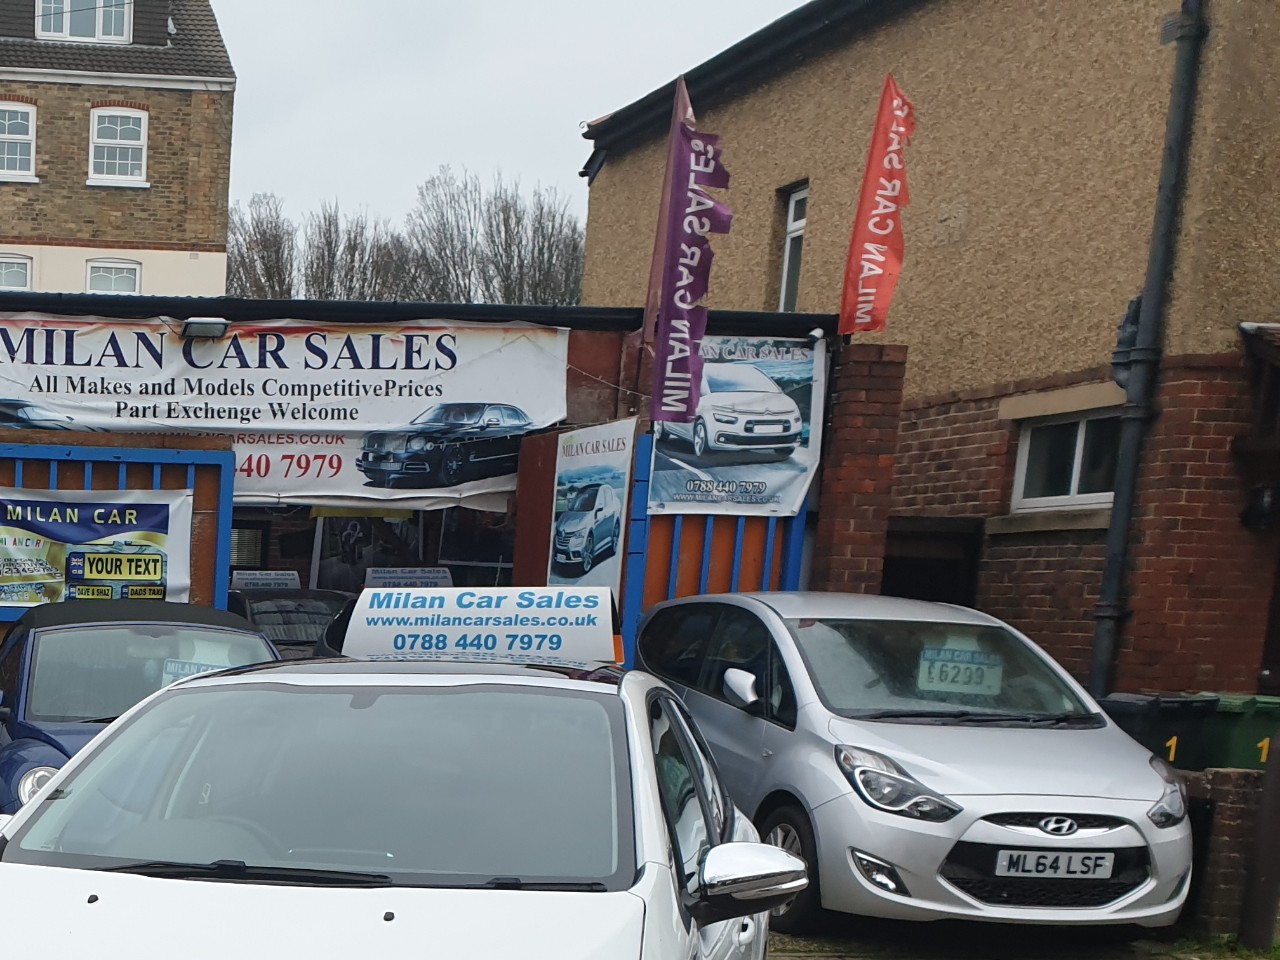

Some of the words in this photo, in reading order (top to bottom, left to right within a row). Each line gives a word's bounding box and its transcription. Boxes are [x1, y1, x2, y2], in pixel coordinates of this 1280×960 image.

[182, 333, 290, 370] CAR
[304, 332, 457, 371] SALES
[721, 346, 759, 360] CAR
[760, 346, 810, 361] SALES
[29, 375, 58, 393] All
[65, 376, 132, 395] Makes
[139, 377, 175, 396] and
[183, 378, 255, 396] Models
[261, 378, 443, 401] CompetitivePrices
[115, 401, 161, 418] Part
[167, 402, 262, 424] Exchenge
[268, 402, 359, 421] Welcome
[562, 443, 584, 457] MILAN
[585, 440, 601, 455] CAR
[602, 437, 627, 453] SALES
[234, 454, 271, 478] 40
[280, 454, 343, 478] 7979
[686, 479, 713, 492] 0788
[714, 480, 737, 493] 440
[739, 480, 768, 493] 7979
[7, 505, 78, 524] MILAN
[94, 509, 137, 525] CAR
[87, 556, 122, 575] YOUR
[127, 558, 159, 575] TEXT
[130, 588, 146, 596] DADS
[149, 588, 163, 596] TAXI
[369, 592, 446, 609] Milan
[456, 592, 508, 609] Car
[516, 591, 599, 609] Sales
[366, 614, 597, 627] www.milancarsales.co.uk
[393, 634, 448, 650] 0788
[455, 634, 497, 650] 440
[505, 634, 562, 650] 7979
[166, 661, 198, 675] MILAN
[1166, 736, 1178, 762] 1
[1257, 737, 1270, 763] 1
[1007, 854, 1060, 874] ML64
[1066, 855, 1106, 875] LSF
